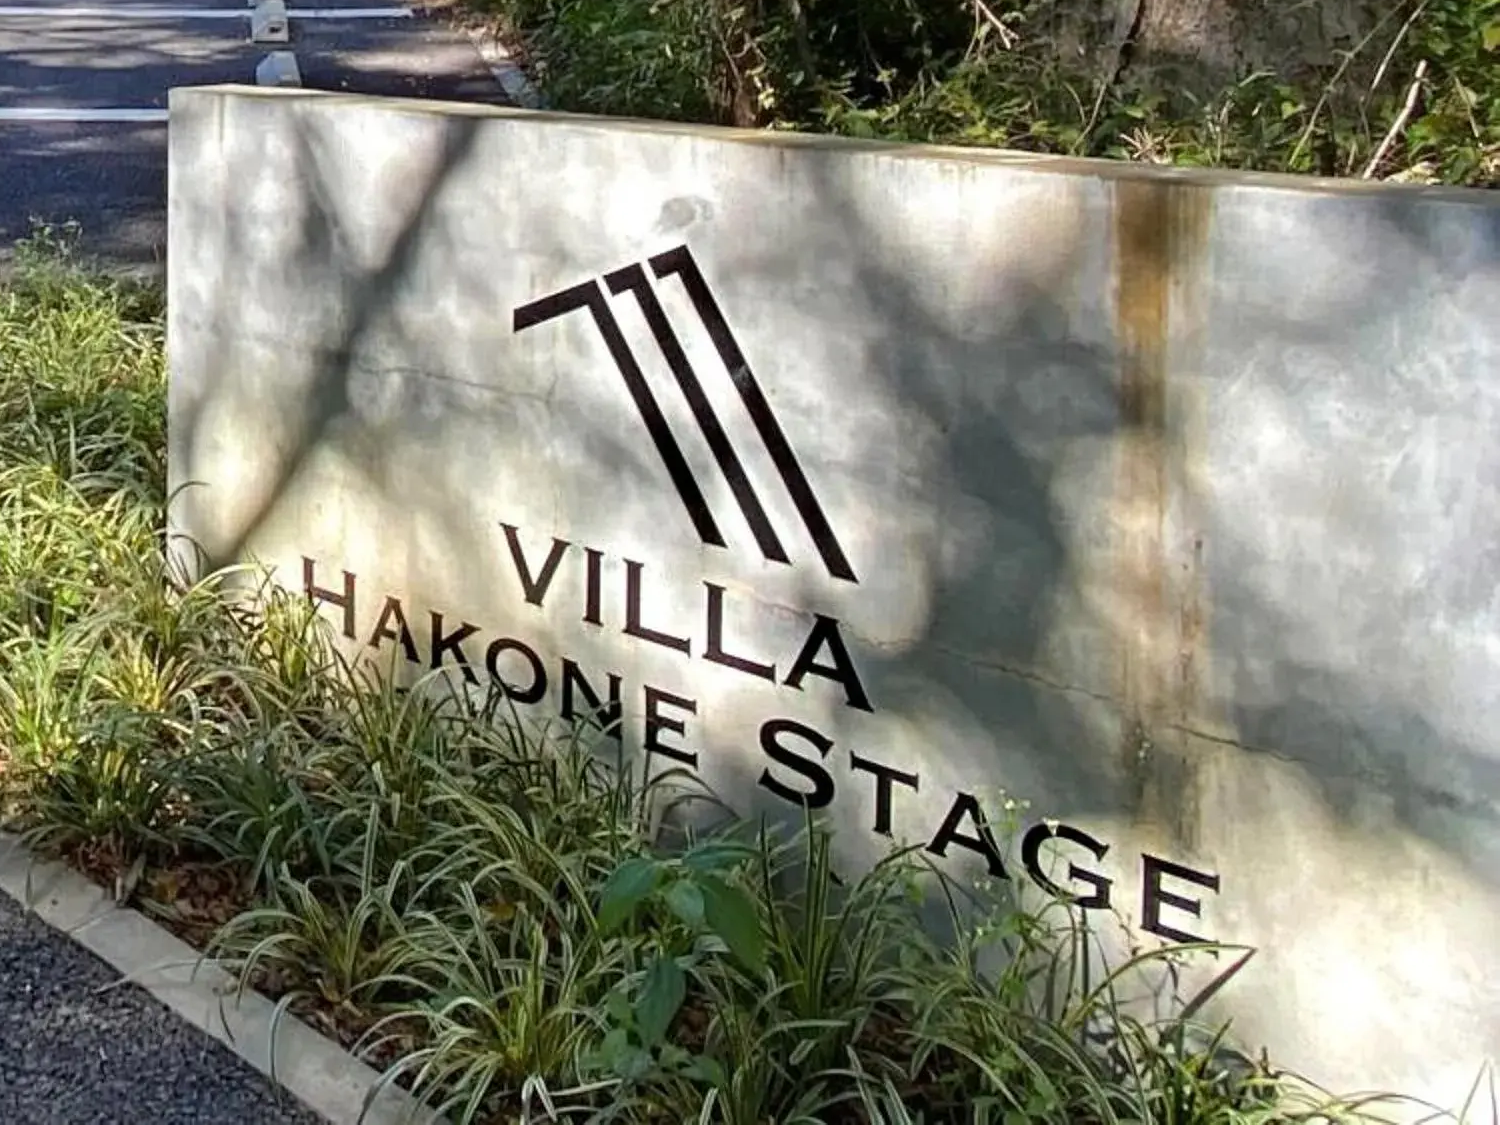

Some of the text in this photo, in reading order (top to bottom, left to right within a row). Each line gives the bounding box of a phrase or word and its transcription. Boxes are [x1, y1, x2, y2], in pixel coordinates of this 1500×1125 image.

[302, 555, 1221, 960] HAKONE STAGE
[501, 523, 874, 713] VILLA
